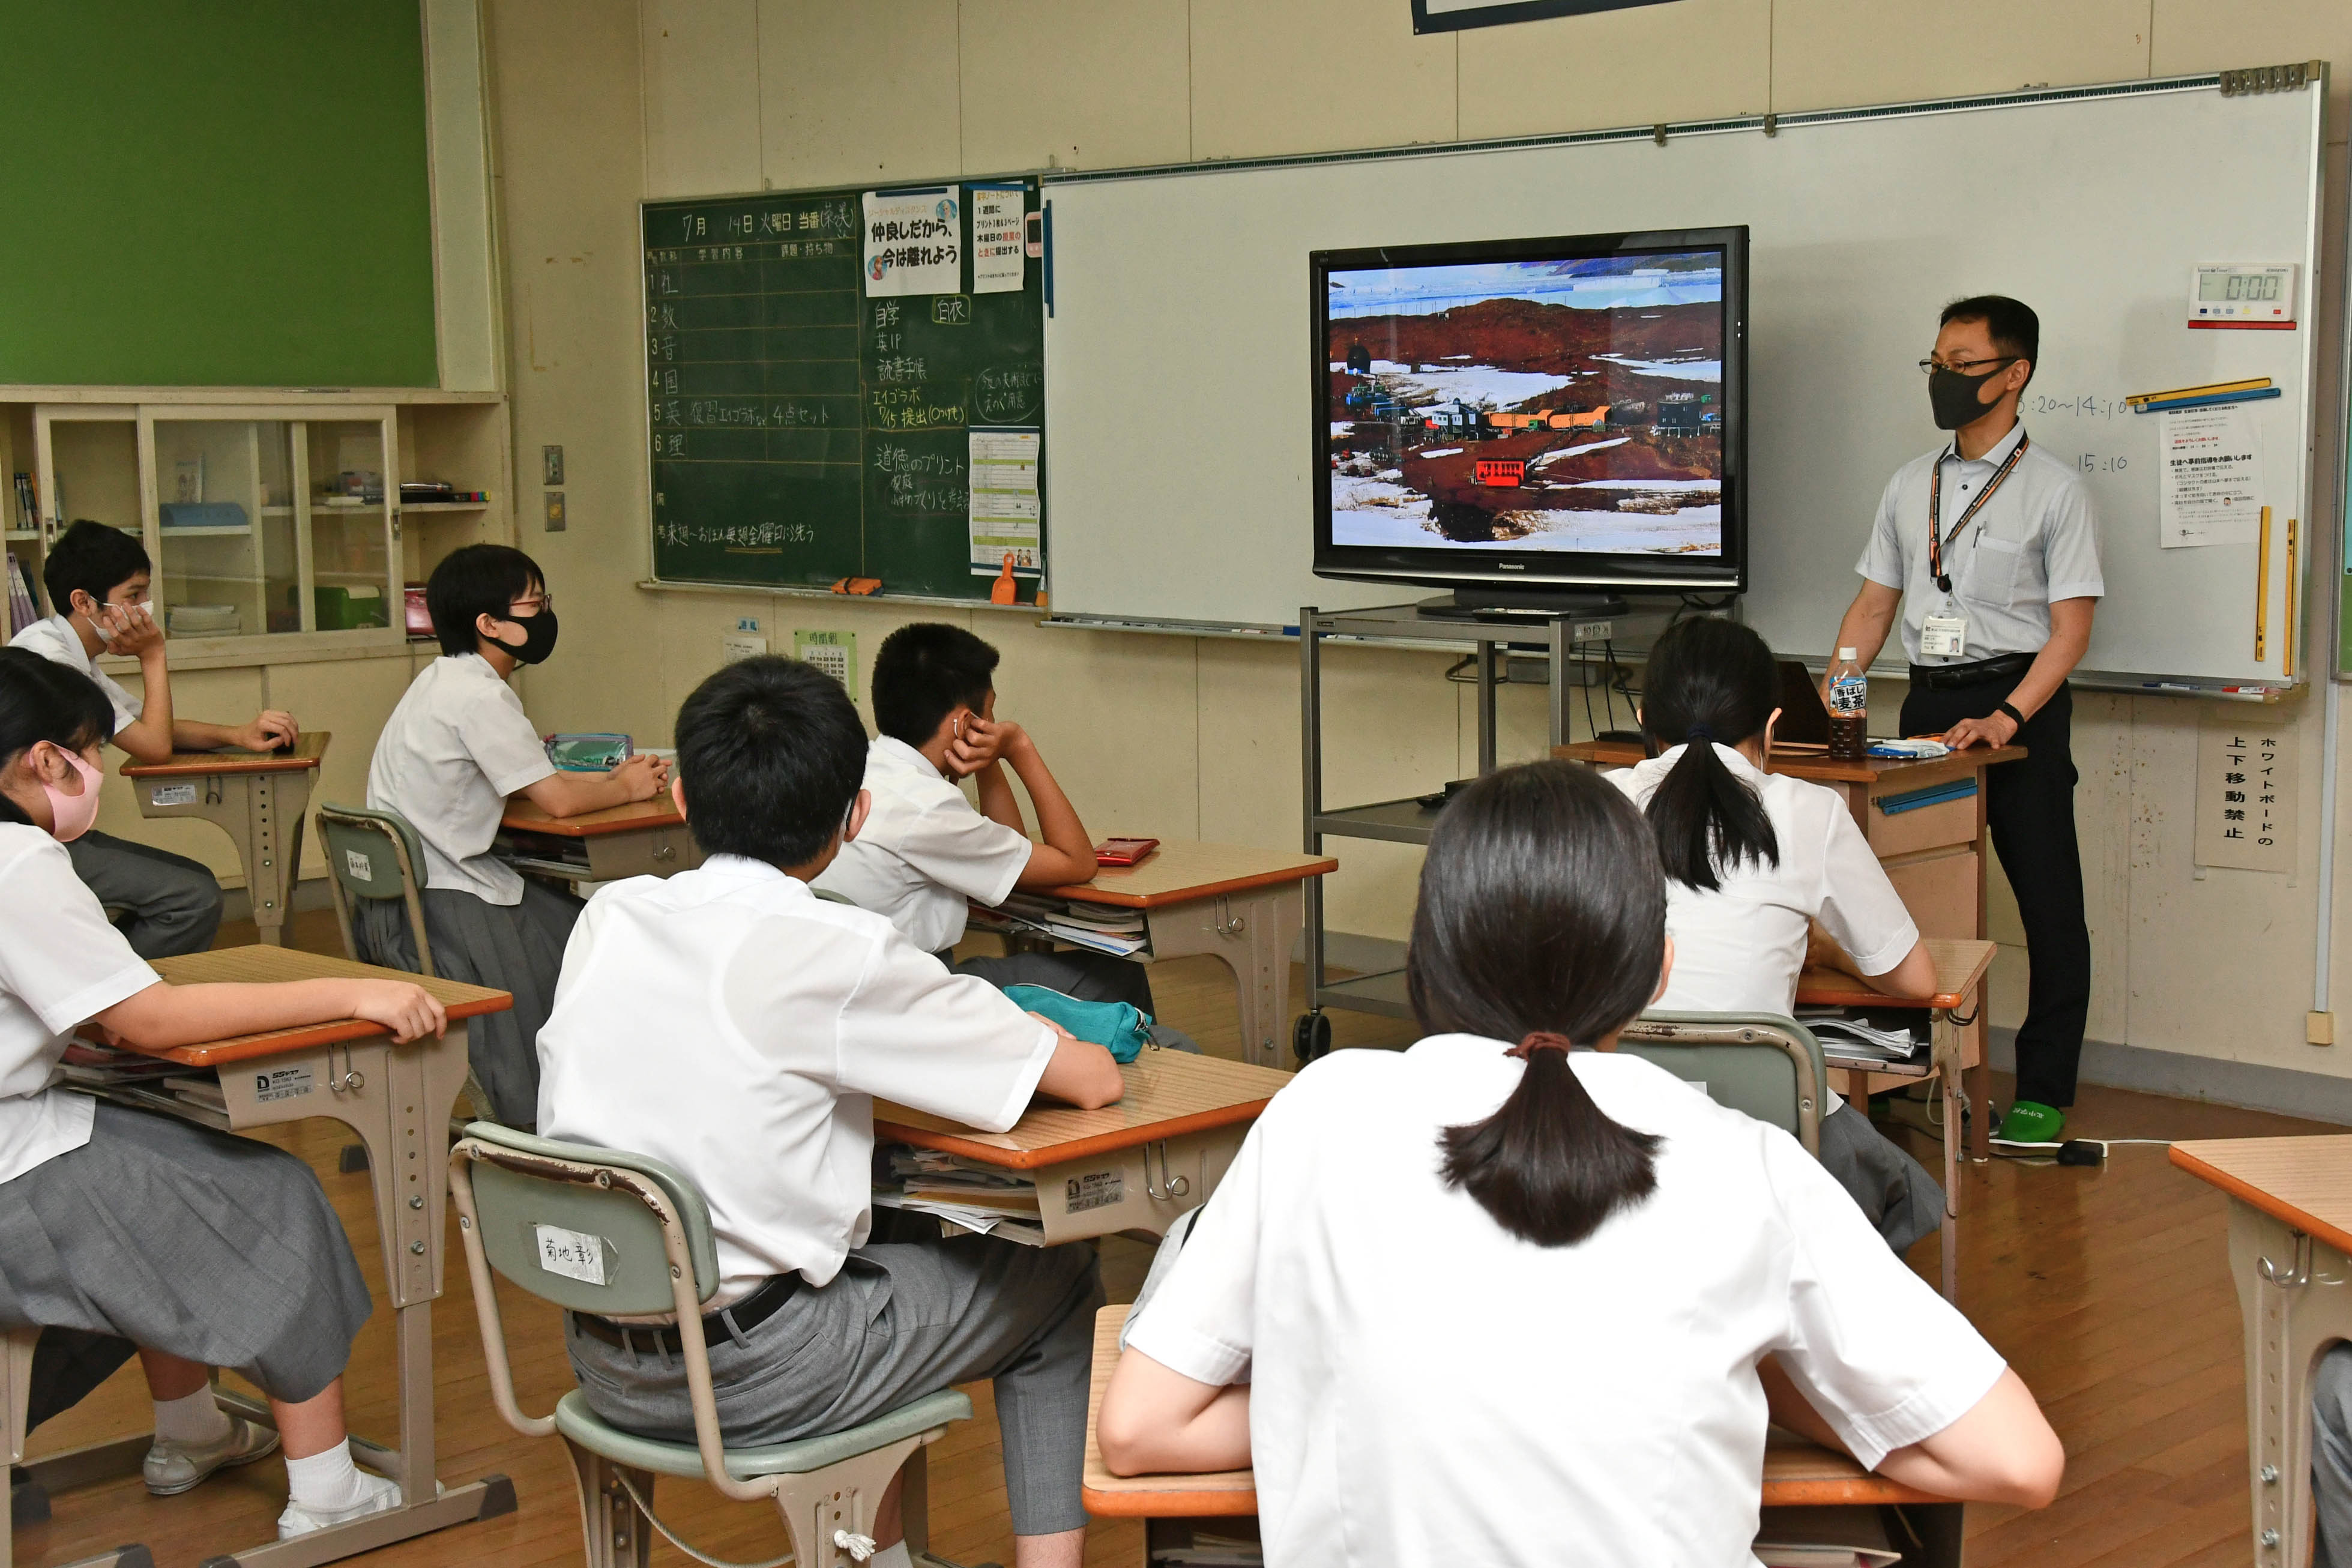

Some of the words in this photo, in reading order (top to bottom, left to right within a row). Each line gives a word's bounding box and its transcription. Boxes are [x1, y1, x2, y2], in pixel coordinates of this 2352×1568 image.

[871, 219, 952, 243] 仲良しだから、
[882, 244, 957, 268] 今は離れよう
[1837, 686, 1863, 697] 香ばし
[1838, 694, 1864, 710] 麦茶
[2224, 737, 2247, 839] 上下移動禁止
[2257, 738, 2276, 846] ホワイトボードの
